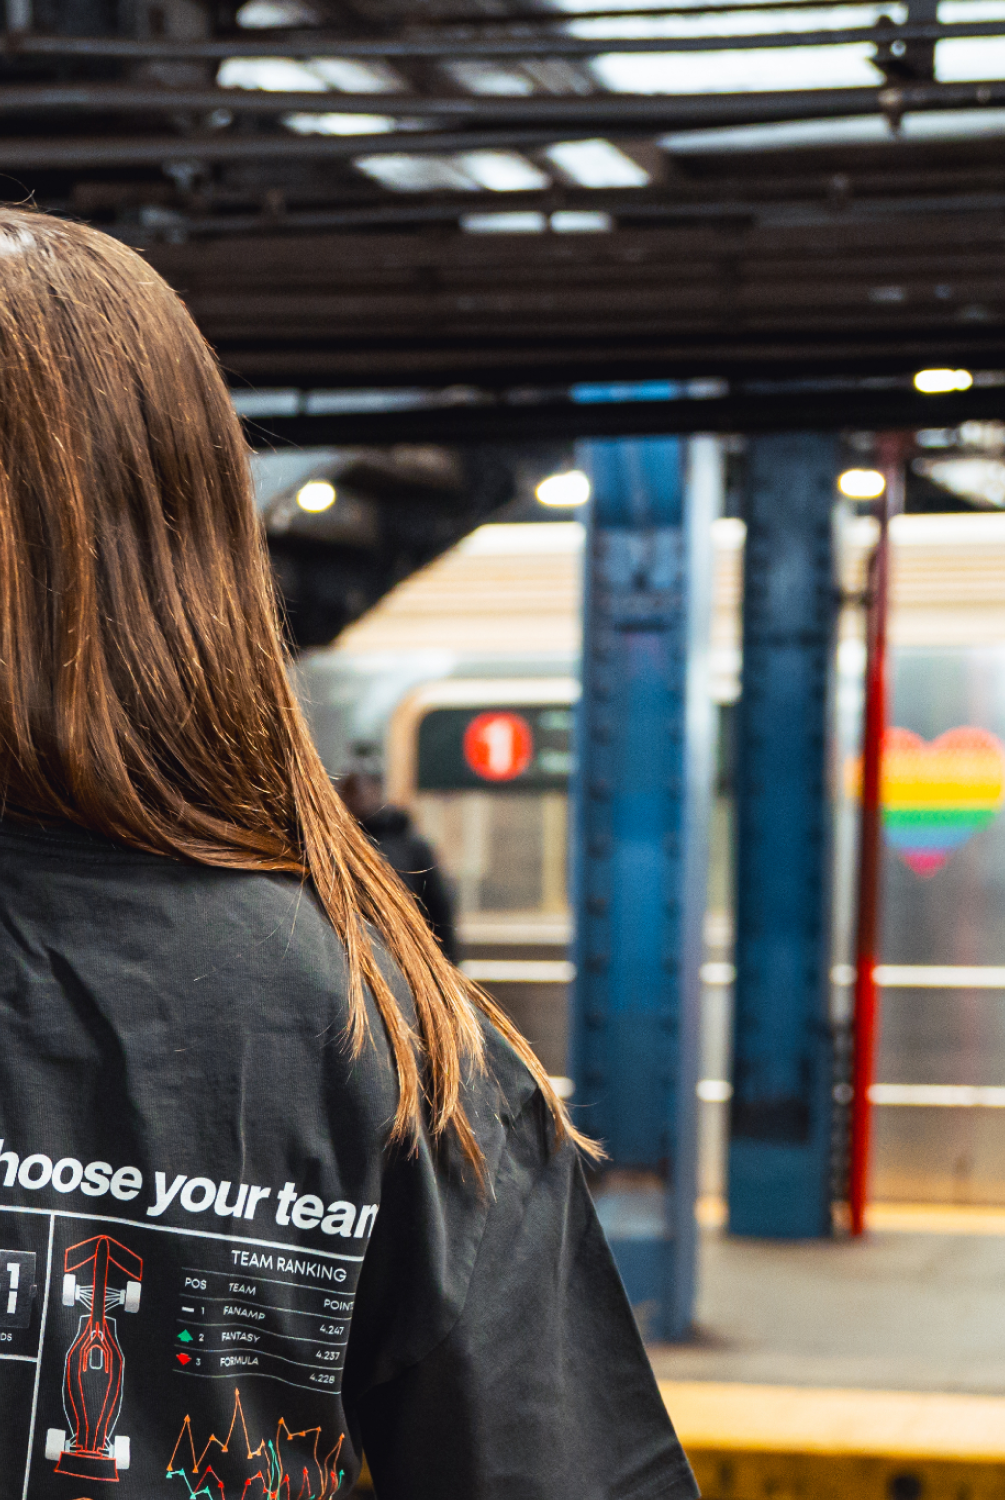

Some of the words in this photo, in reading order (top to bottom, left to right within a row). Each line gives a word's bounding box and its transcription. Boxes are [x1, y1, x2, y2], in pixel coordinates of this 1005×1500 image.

[146, 1171, 271, 1220] your
[231, 1250, 273, 1270] TEAM
[277, 1257, 347, 1283] RANKING
[185, 1277, 207, 1290] POS
[229, 1283, 256, 1296] TEAM
[223, 1306, 266, 1321] FANAMP
[319, 1324, 344, 1336] 4.247
[198, 1333, 205, 1342] 2
[221, 1331, 261, 1343] FANTASY
[315, 1350, 340, 1361] 4.237
[195, 1358, 201, 1366] 3
[220, 1356, 259, 1367] FORMULA
[309, 1373, 335, 1384] 4.228
